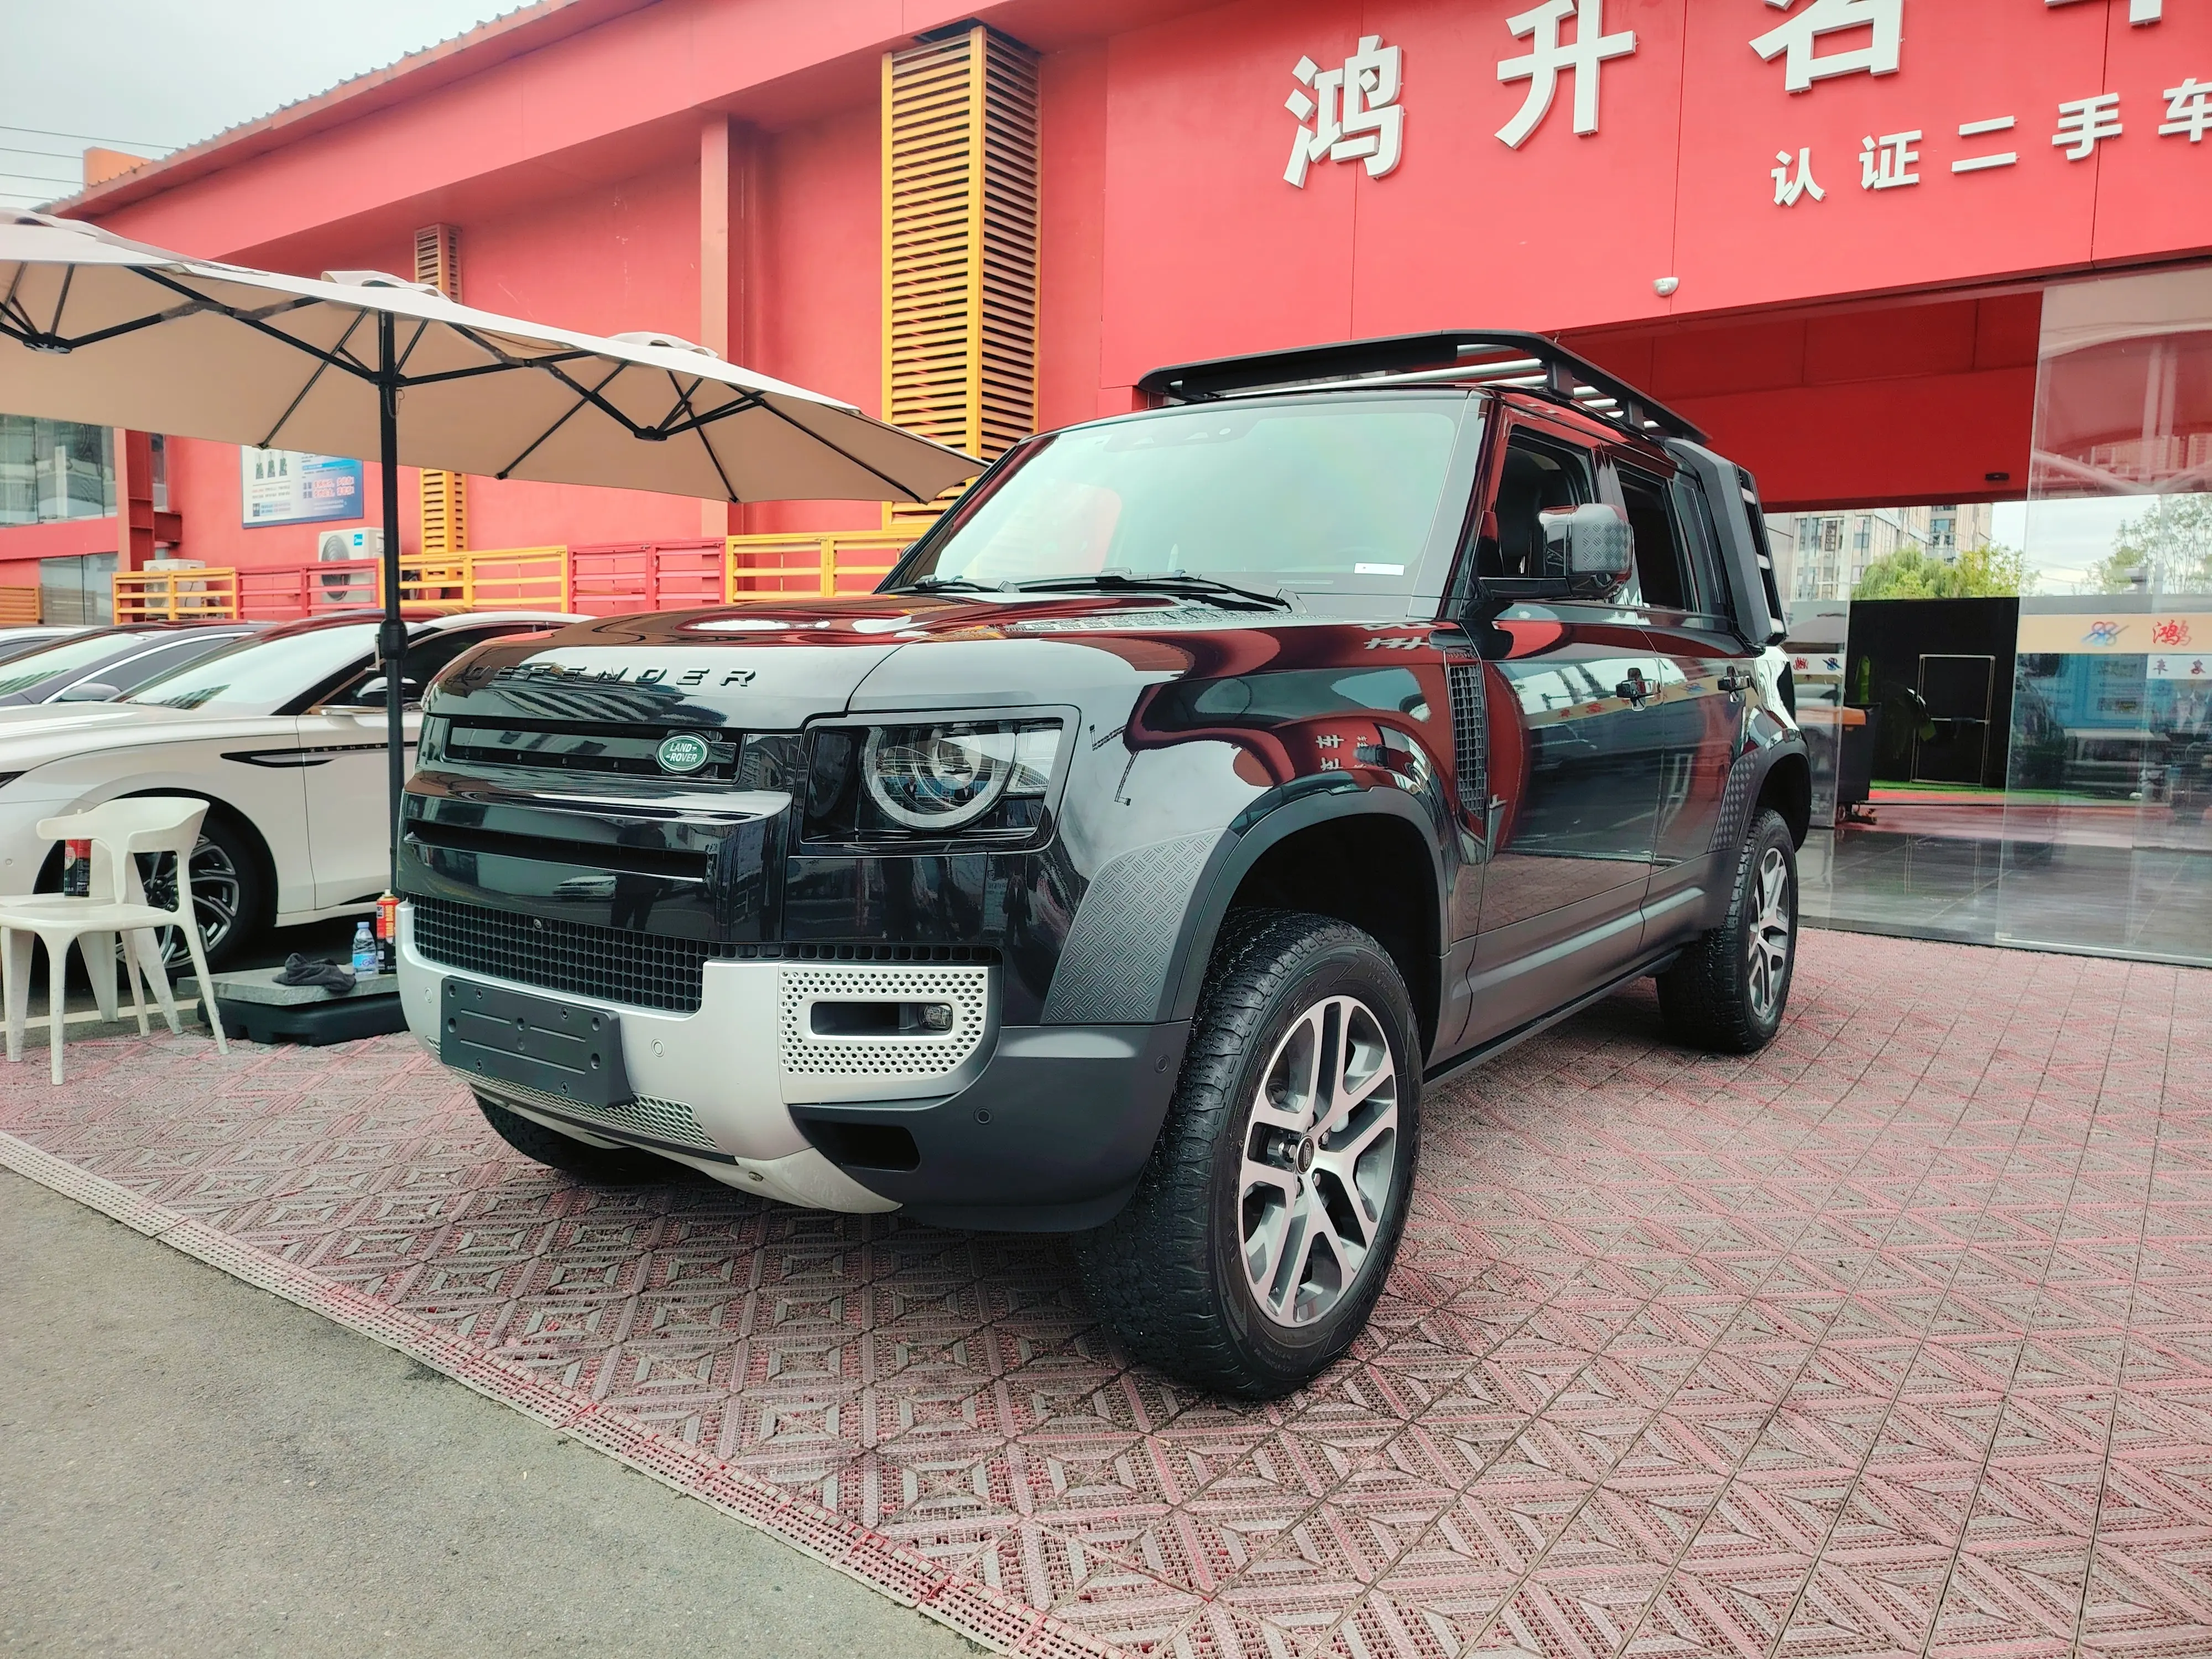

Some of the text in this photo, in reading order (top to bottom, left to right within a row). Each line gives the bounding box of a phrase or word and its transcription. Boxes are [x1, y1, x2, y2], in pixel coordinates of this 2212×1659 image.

[1282, 0, 2163, 189] 鸿升名
[1771, 78, 2212, 207] 认证二手车
[464, 665, 756, 687] DEFENDER
[669, 742, 692, 753] LAND
[669, 752, 698, 763] ROVER
